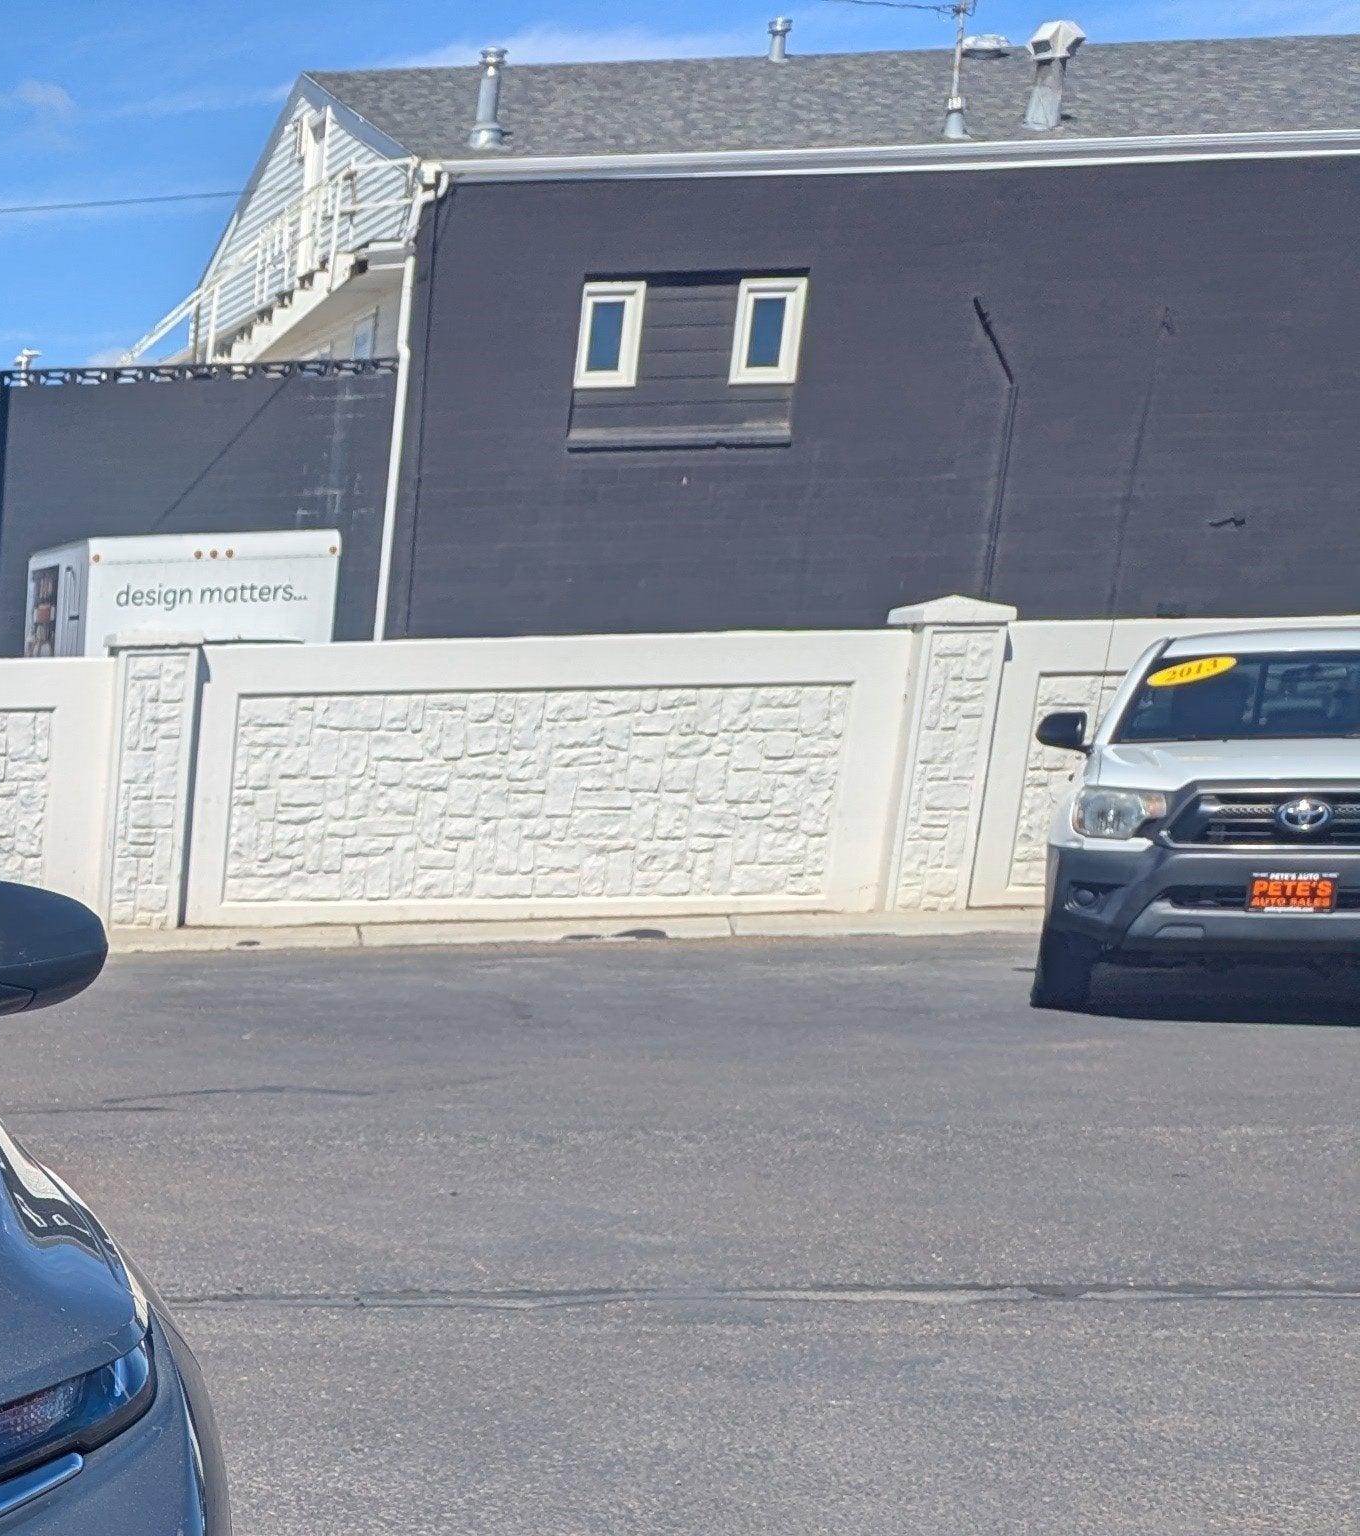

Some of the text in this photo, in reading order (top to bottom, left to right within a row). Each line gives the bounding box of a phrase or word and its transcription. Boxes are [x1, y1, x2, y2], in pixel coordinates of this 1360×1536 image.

[115, 583, 309, 612] design matters...
[1253, 880, 1332, 896] PETE'S
[1251, 897, 1286, 907] AUTO
